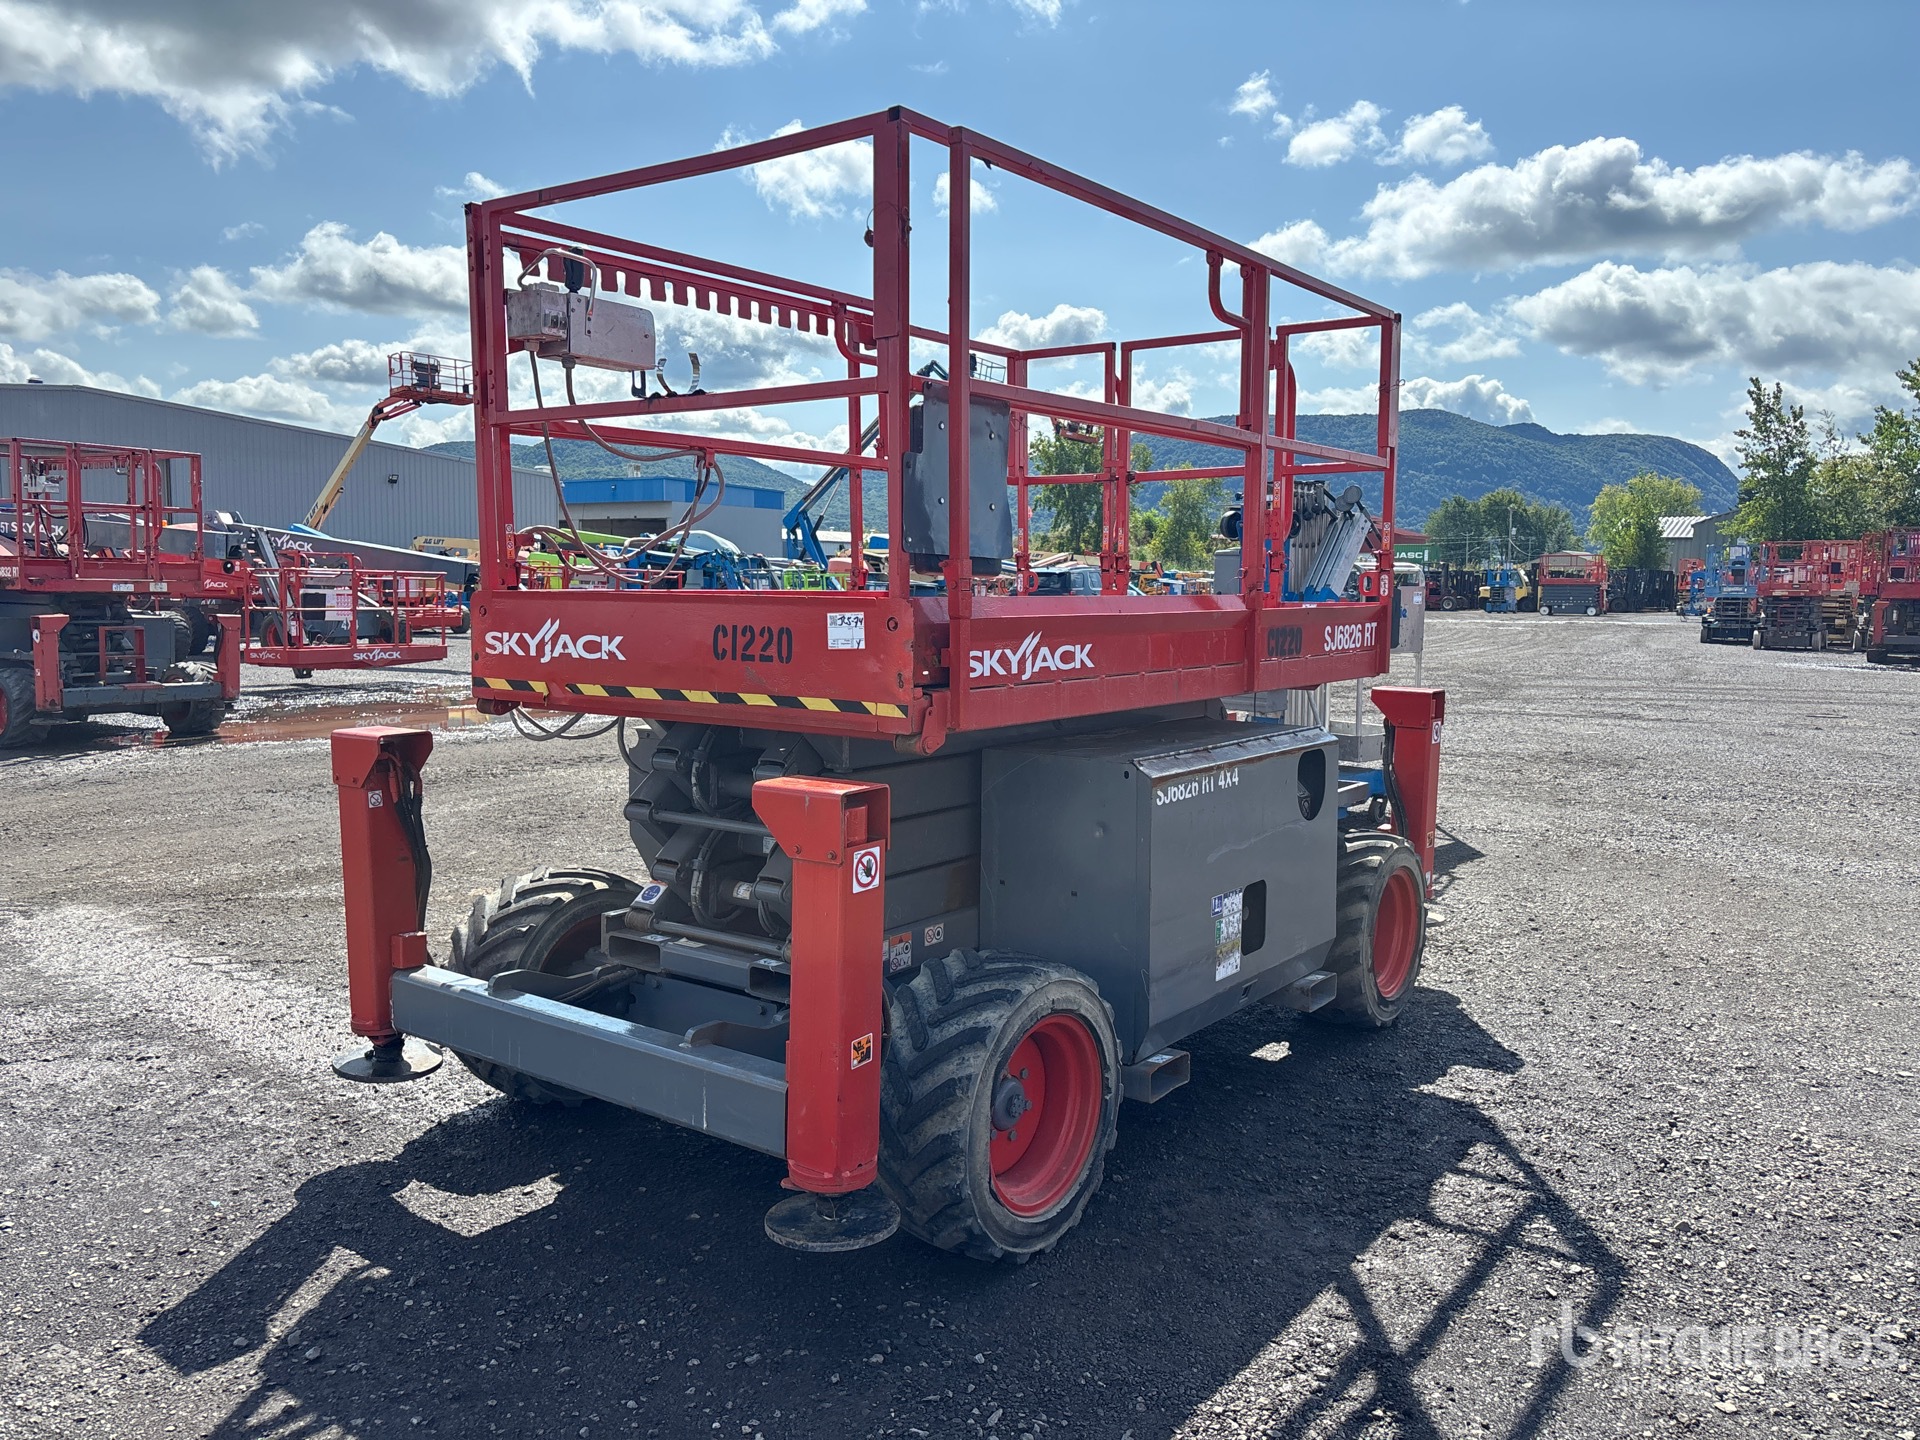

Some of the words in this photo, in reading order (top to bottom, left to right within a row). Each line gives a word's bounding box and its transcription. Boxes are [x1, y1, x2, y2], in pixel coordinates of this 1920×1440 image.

[353, 648, 402, 661] SKYJACK
[484, 617, 627, 664] SKYJACK
[969, 630, 1095, 681] SKYJACK
[1324, 623, 1363, 652] SJ6826
[1363, 621, 1378, 647] RT
